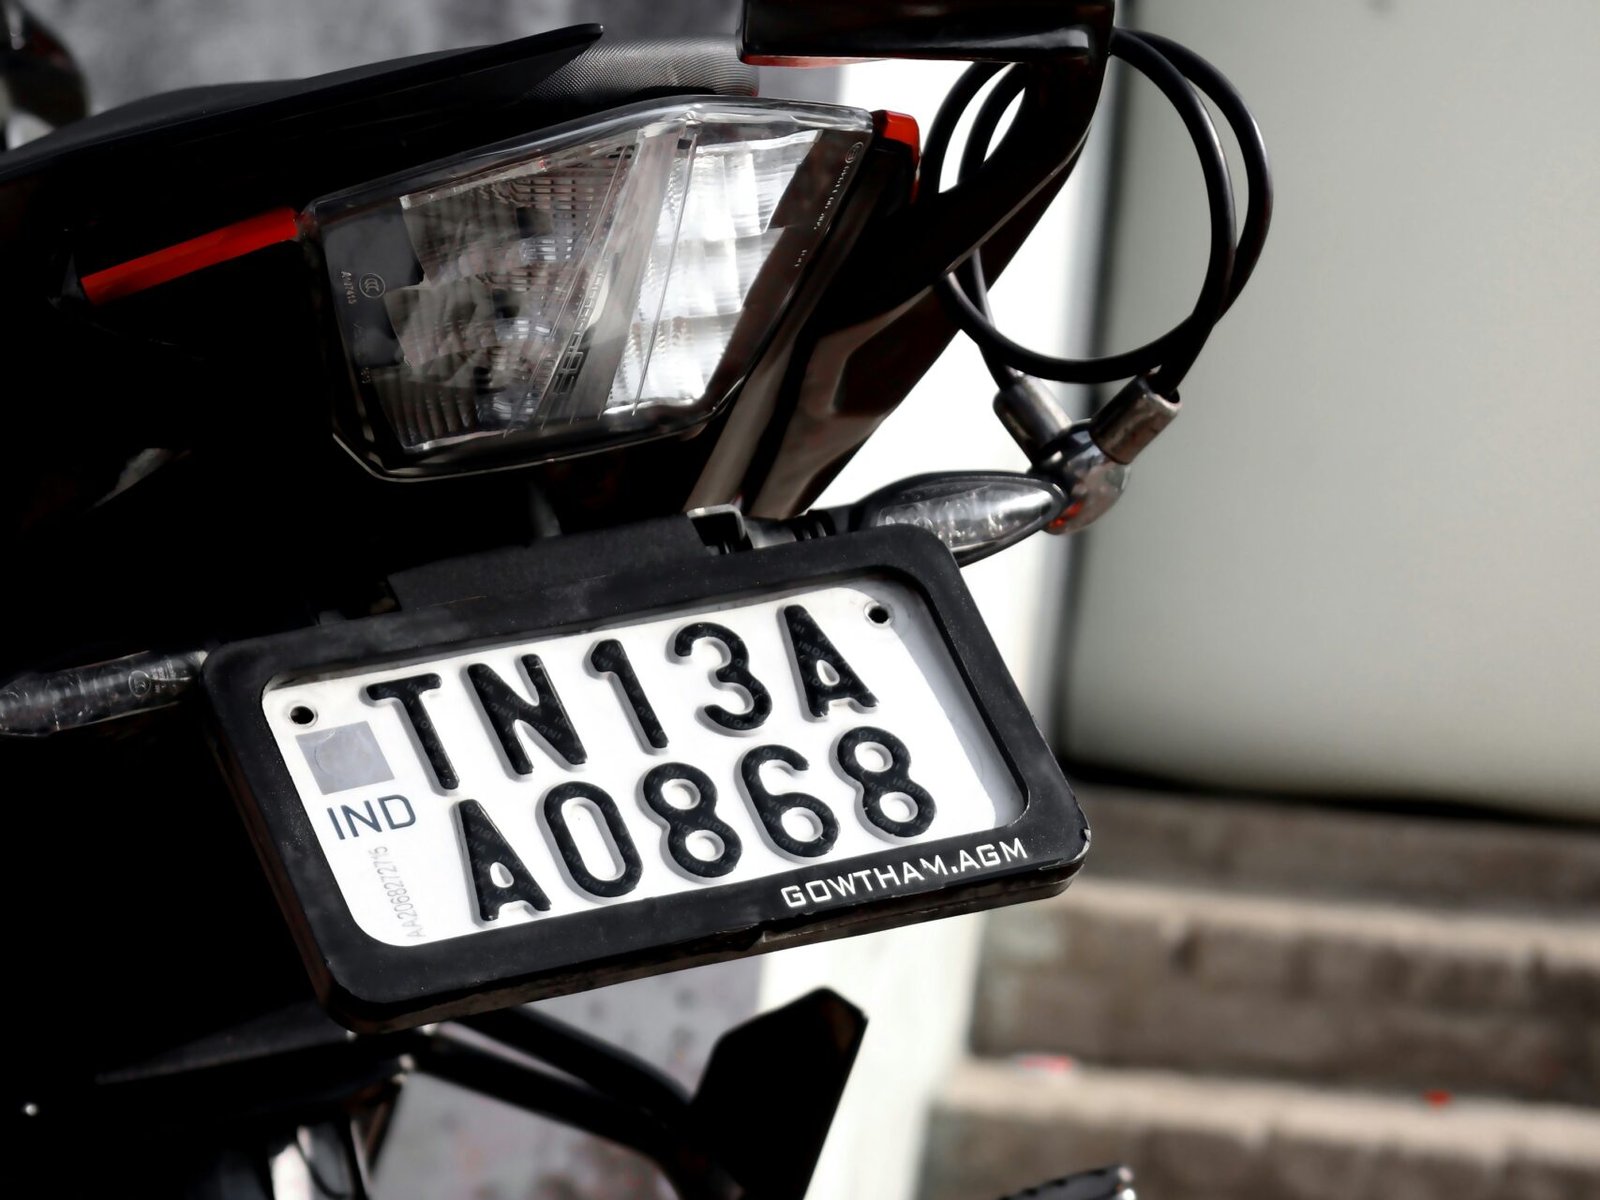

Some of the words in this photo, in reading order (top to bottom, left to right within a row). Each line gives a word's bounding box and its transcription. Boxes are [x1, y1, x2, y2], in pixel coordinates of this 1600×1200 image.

[366, 605, 880, 790] TN13A
[327, 794, 416, 840] IND
[459, 726, 936, 922] A0868
[780, 837, 1028, 908] GOWTHAM.AGM
